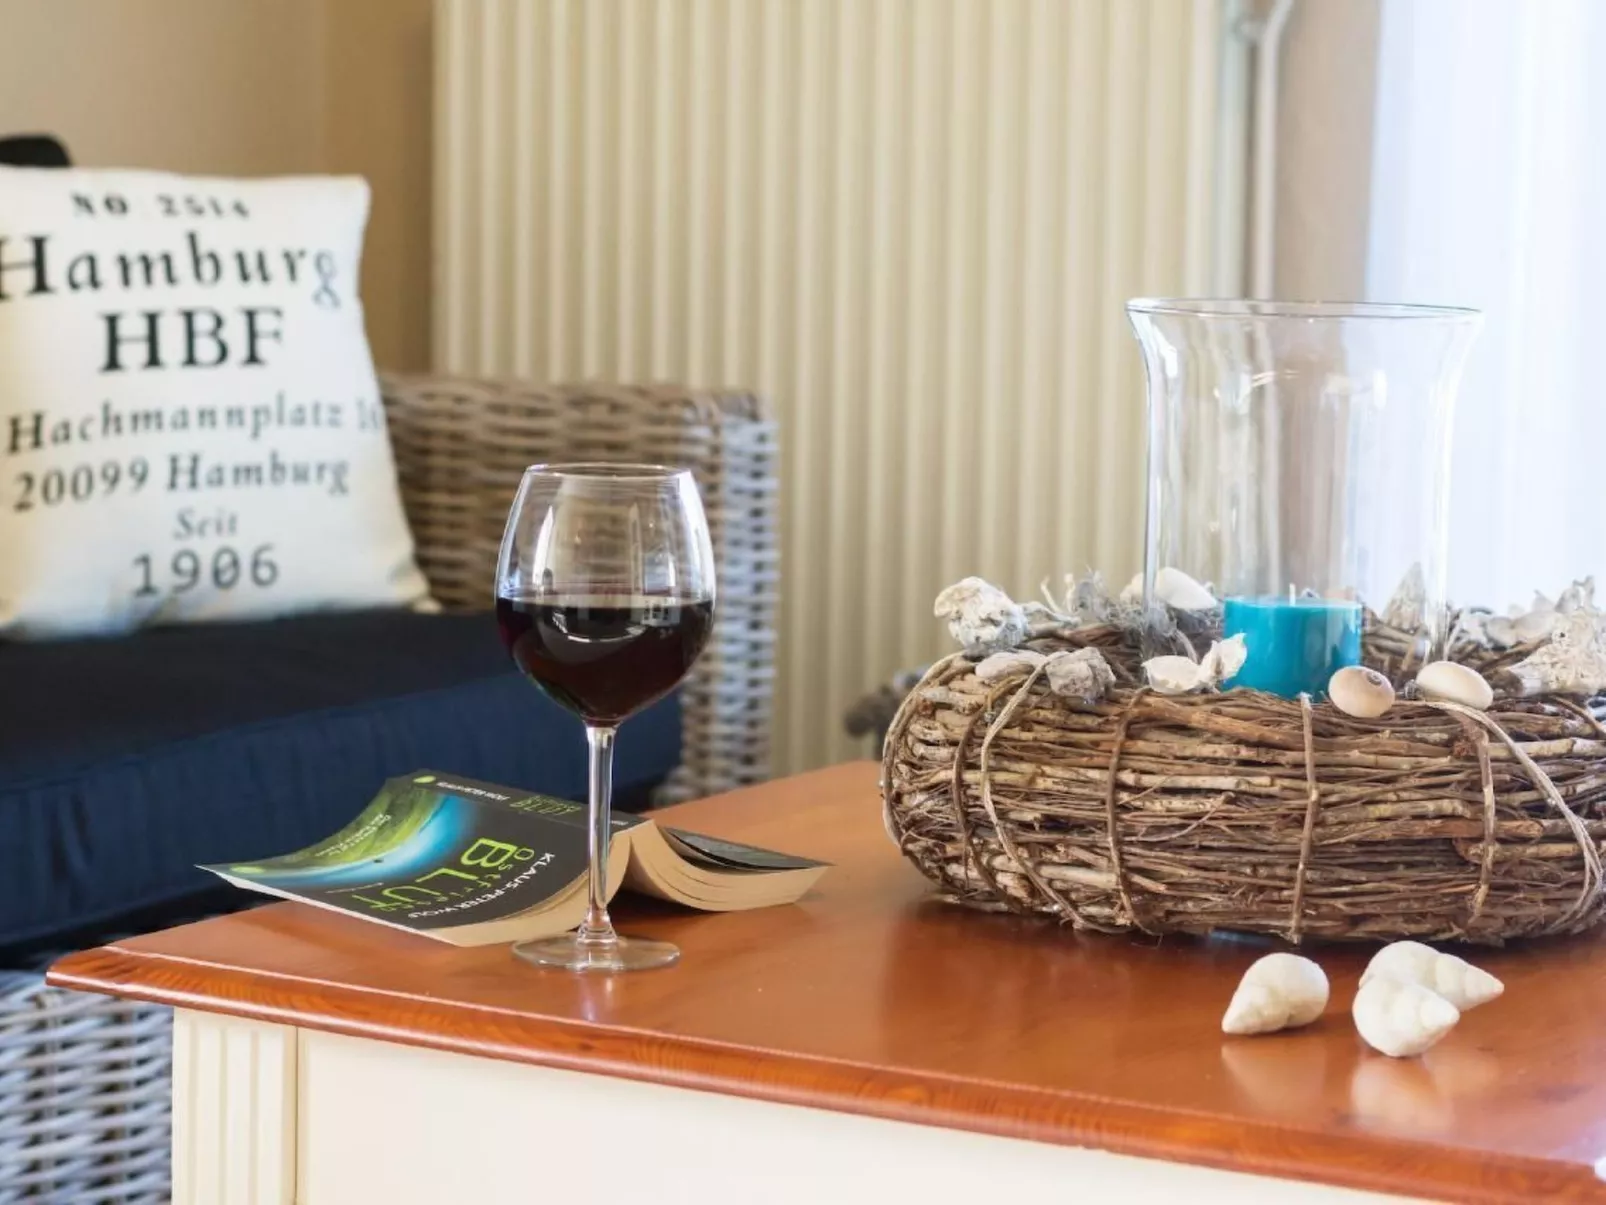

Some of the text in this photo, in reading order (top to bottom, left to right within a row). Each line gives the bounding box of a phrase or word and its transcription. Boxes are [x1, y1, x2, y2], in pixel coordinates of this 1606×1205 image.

[0, 231, 341, 309] Hamburg
[98, 307, 285, 373] HBF
[6, 392, 344, 456] Hachmannplatz
[14, 449, 350, 513] 20099 Hamburg
[132, 543, 281, 598] 1906
[352, 838, 518, 908] BLUT
